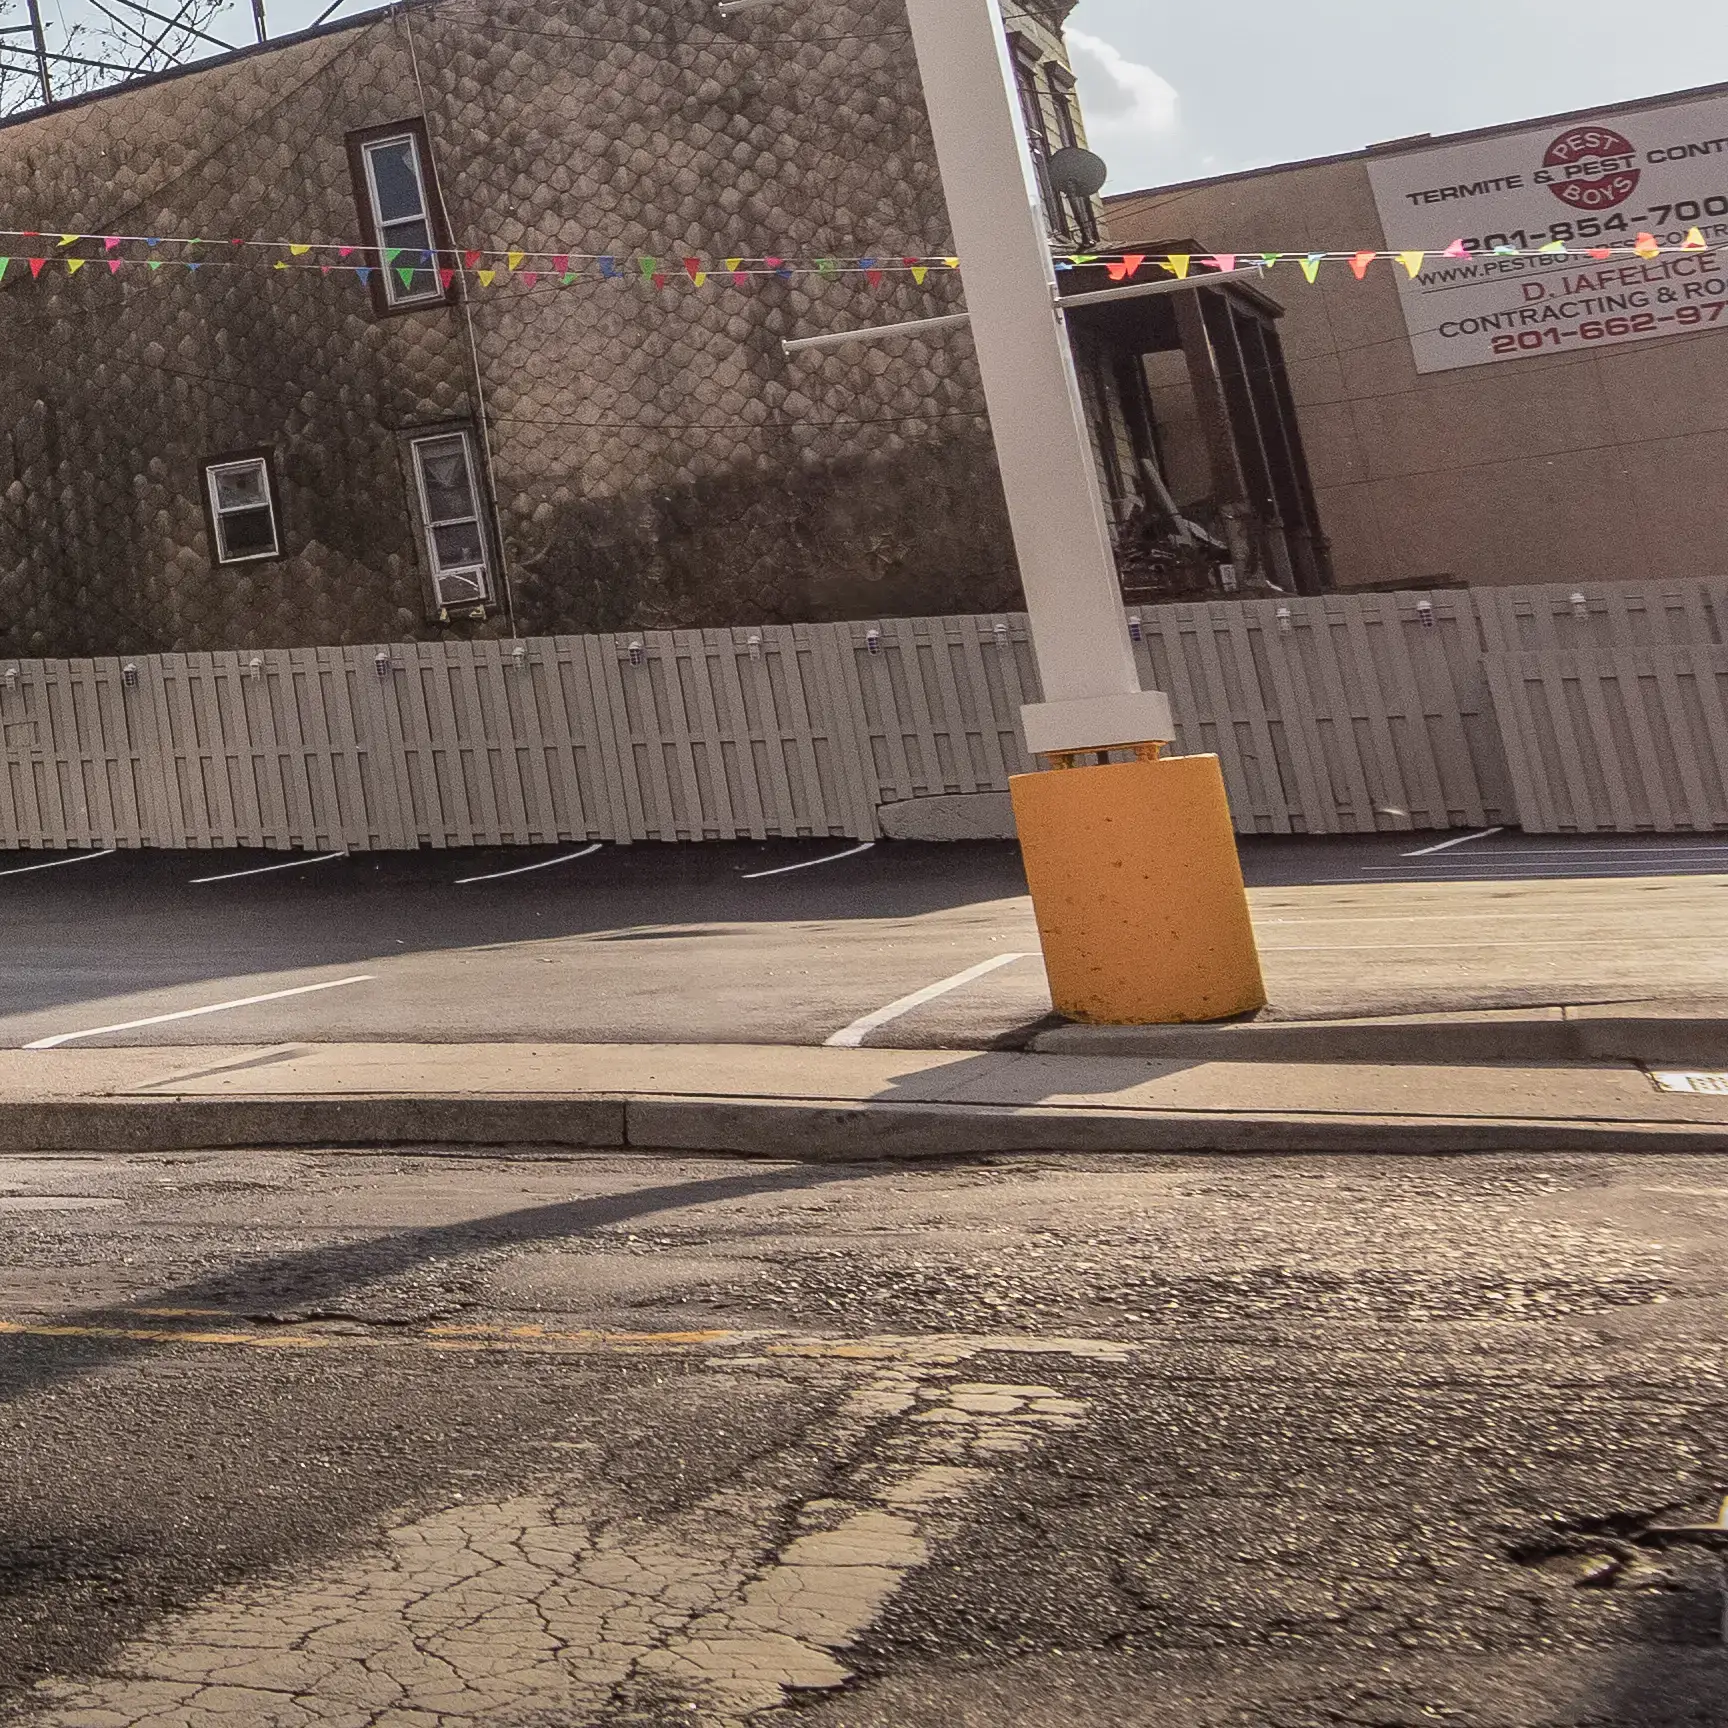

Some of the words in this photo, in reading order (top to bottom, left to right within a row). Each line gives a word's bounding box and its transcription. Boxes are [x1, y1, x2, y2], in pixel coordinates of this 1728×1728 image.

[1405, 174, 1525, 206] TERMITE
[1533, 169, 1555, 185] &
[1564, 154, 1636, 180] PEST
[1646, 136, 1728, 164] CONT
[1552, 132, 1620, 160] PEST
[1563, 176, 1633, 205] BOYS
[1522, 280, 1556, 302] D.
[1562, 252, 1722, 296] IAFELICE
[1438, 289, 1650, 339] CONTRACTING
[1657, 286, 1678, 304] &
[1683, 278, 1728, 300] RO
[1490, 299, 1728, 355] 201-662-97
